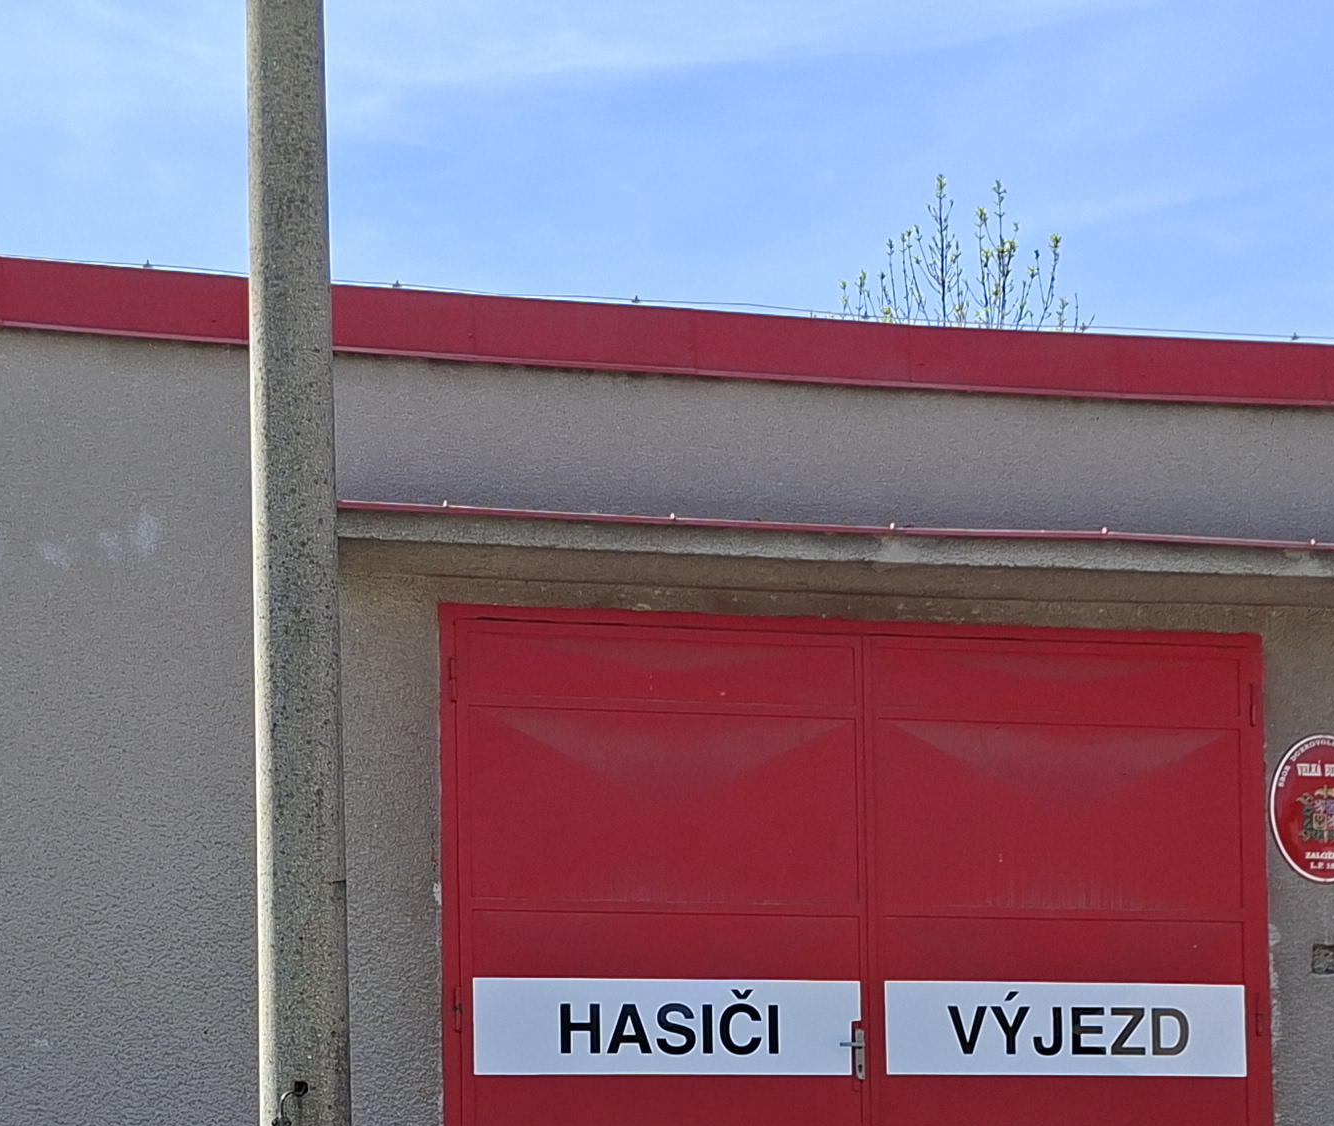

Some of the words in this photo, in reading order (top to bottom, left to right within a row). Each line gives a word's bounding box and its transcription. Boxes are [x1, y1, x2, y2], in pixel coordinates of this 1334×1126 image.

[1296, 760, 1322, 777] VELKÁ
[559, 988, 780, 1056] HASIČI
[947, 991, 1191, 1056] VÝJEZD
